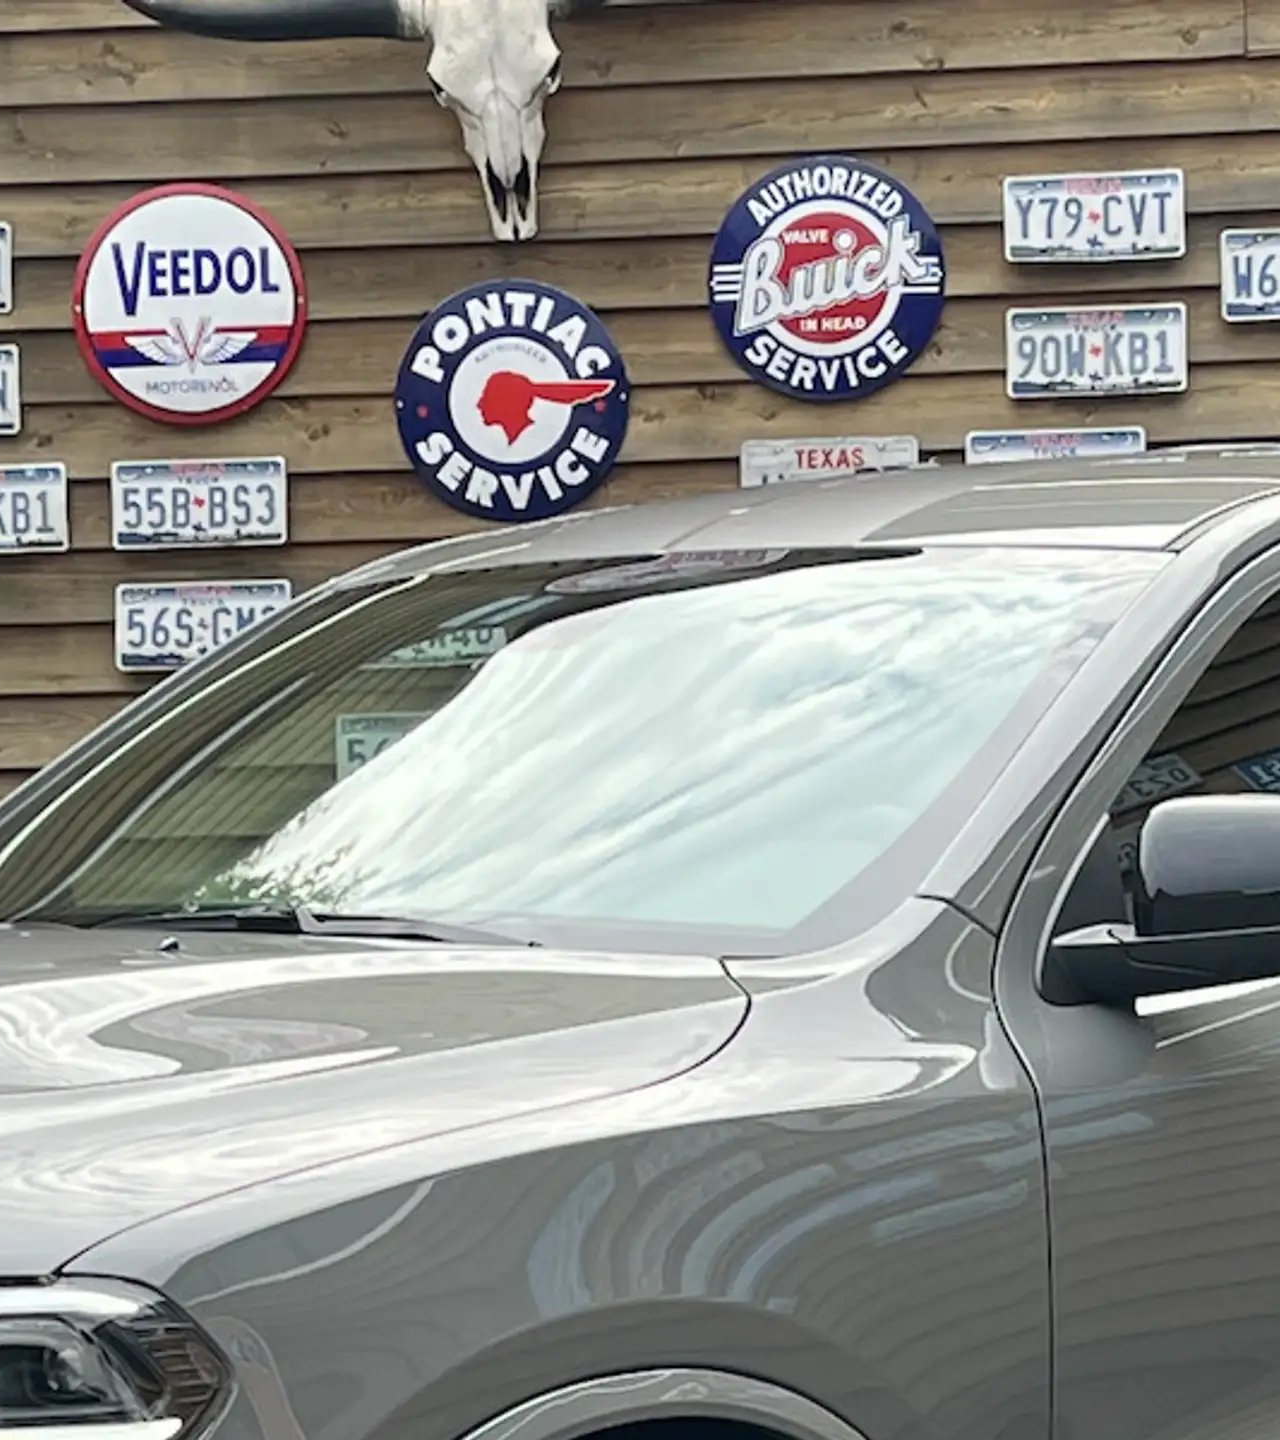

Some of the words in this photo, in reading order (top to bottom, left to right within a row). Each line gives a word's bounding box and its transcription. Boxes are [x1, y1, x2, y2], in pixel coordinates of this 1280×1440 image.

[746, 166, 904, 226] AUTHORIZED
[780, 228, 830, 245] VALVE
[111, 240, 281, 317] VEEDOL
[734, 214, 931, 337] Buick
[411, 291, 611, 383] PONTIAC
[800, 317, 818, 332] IN
[821, 315, 867, 331] HEAD
[744, 330, 908, 391] SERVICE
[416, 428, 610, 510] SERVICE
[794, 447, 866, 470] TEXAS
